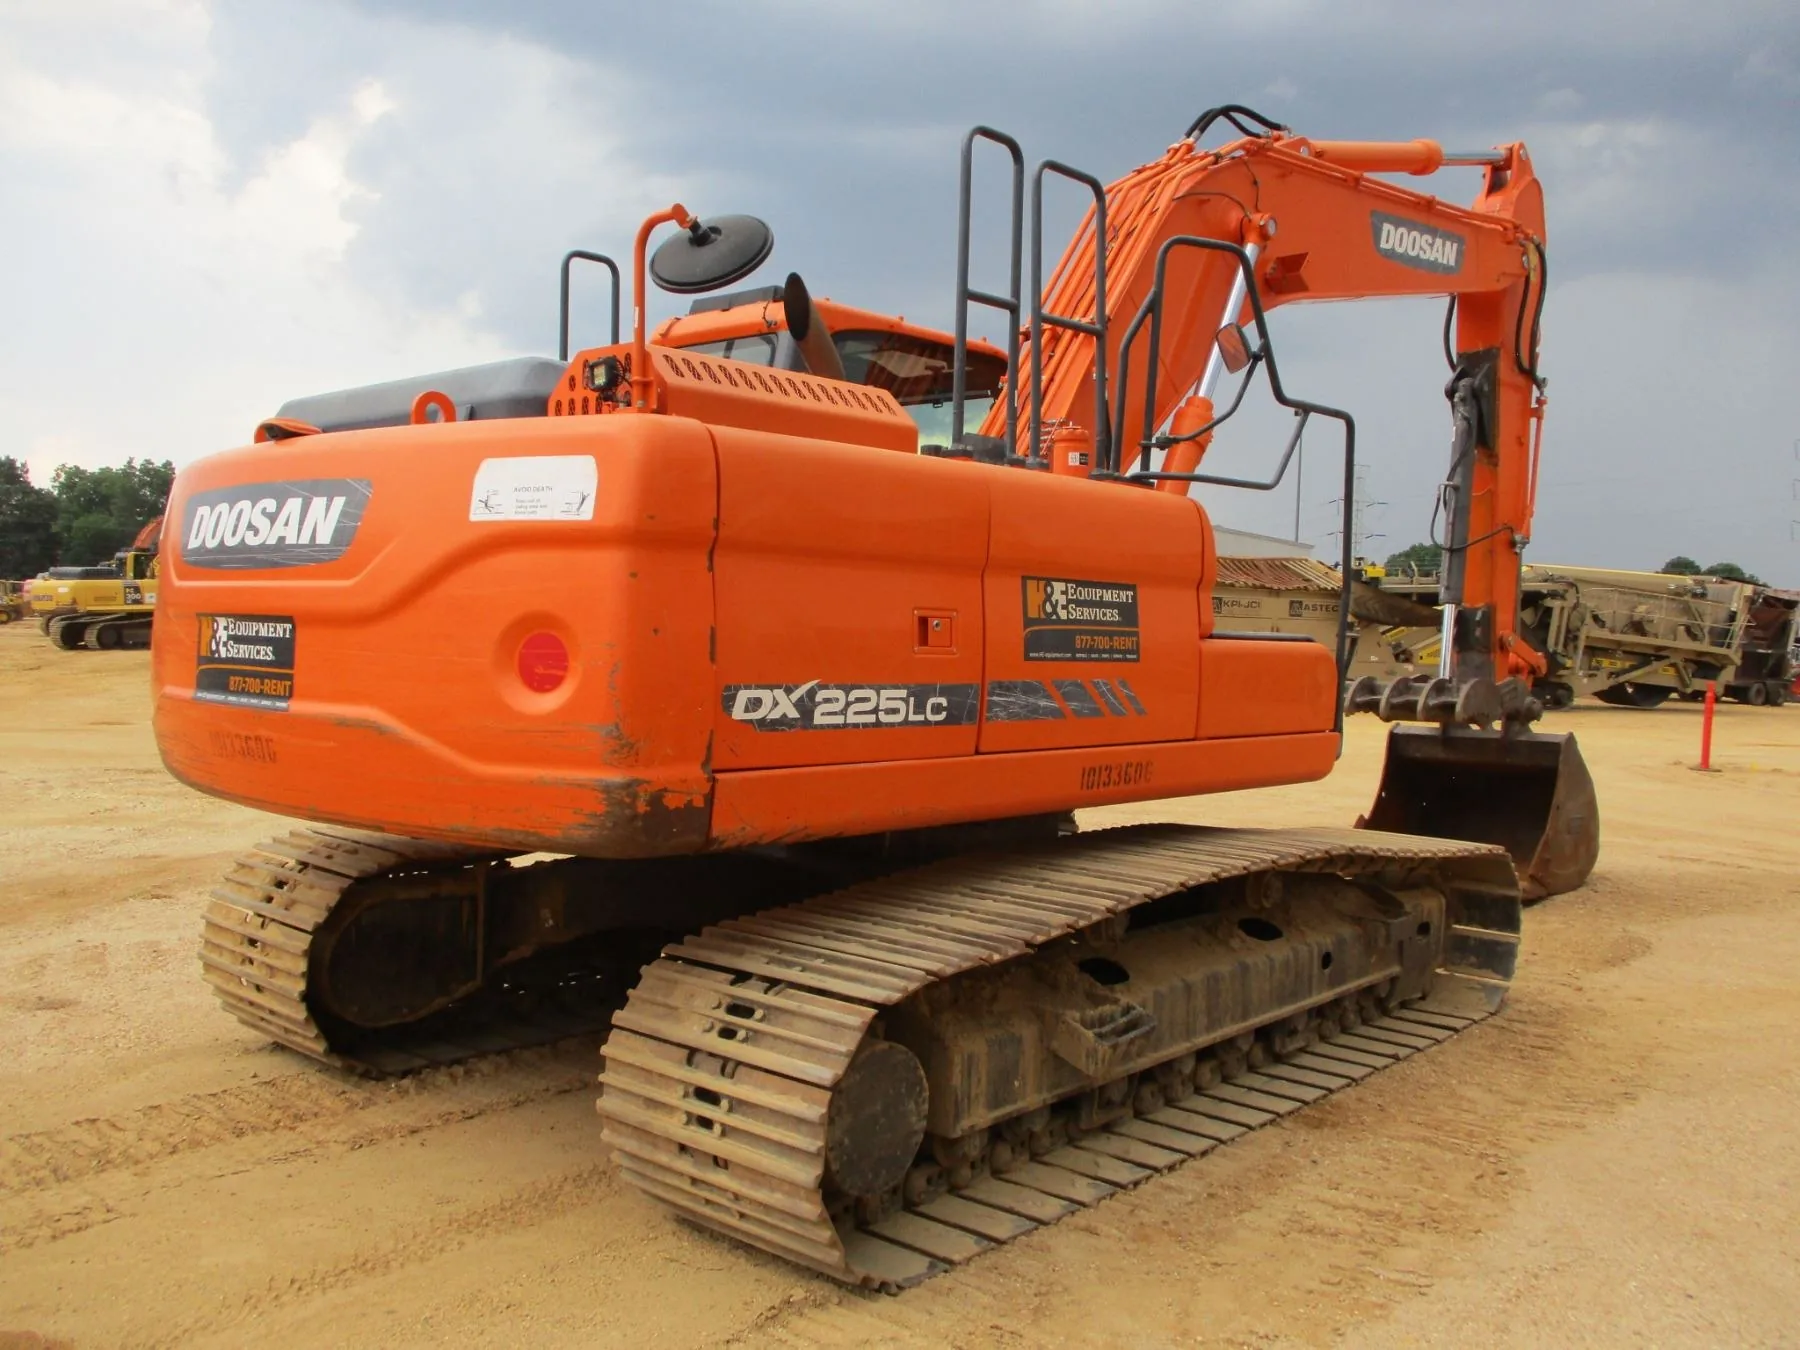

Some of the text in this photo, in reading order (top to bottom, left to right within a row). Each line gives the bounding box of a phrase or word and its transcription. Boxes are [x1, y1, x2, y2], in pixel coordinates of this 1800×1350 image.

[1380, 223, 1458, 266] DOOSAN
[188, 496, 346, 549] DOOSAN
[1067, 583, 1134, 603] EQUIPMENT
[1068, 604, 1119, 621] SERVICES
[228, 618, 293, 638] EQUIPMENT
[227, 640, 273, 660] SERVICES
[1075, 635, 1138, 650] 877-700-RENT
[229, 676, 292, 697] 877-700-RENT
[732, 679, 821, 720] DX
